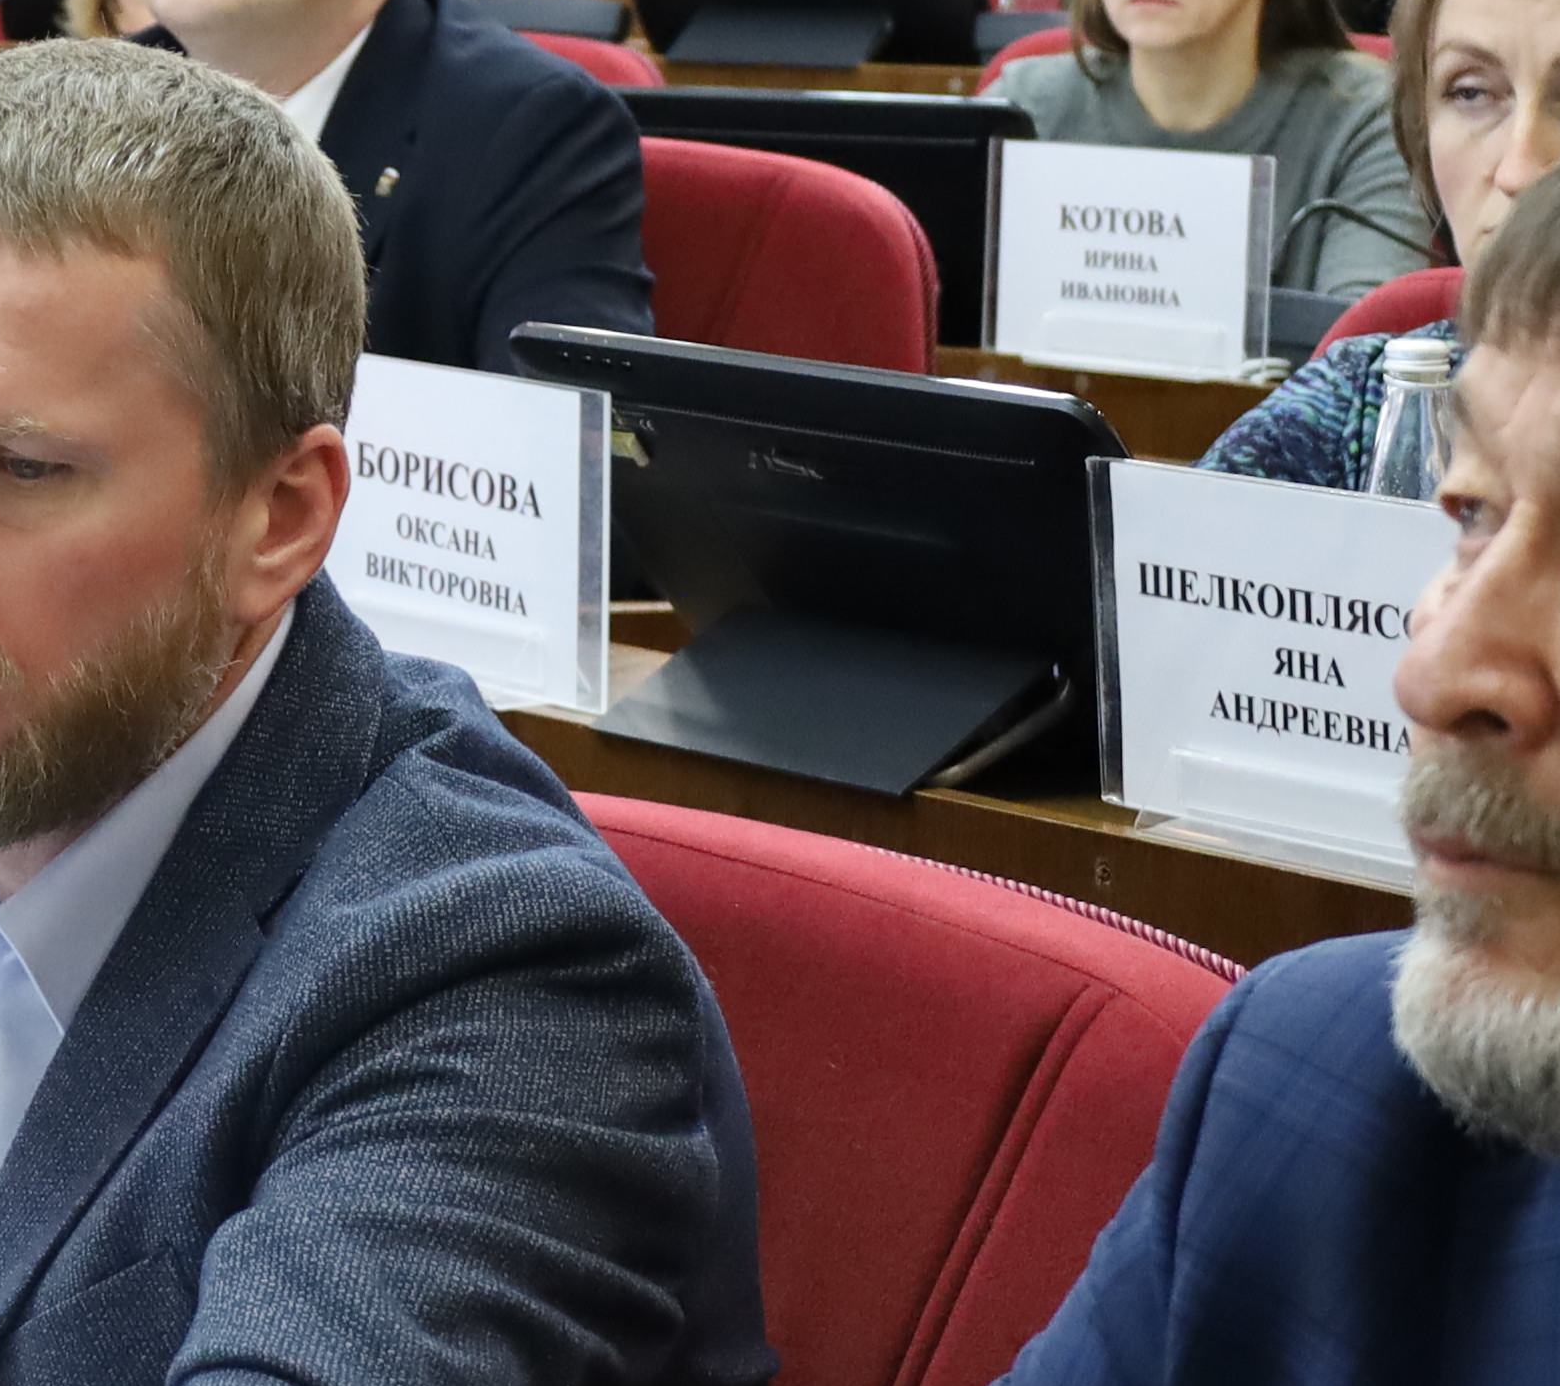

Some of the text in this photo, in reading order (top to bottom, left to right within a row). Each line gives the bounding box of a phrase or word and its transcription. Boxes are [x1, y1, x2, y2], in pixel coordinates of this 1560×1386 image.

[1060, 205, 1185, 238] КОТОВА
[1083, 249, 1158, 273] ИРИНА
[1061, 281, 1180, 307] ИВАНОВНА
[356, 440, 543, 520] БОРИСОВА
[396, 512, 497, 562] ОКСАНА
[365, 551, 528, 617] ВИКТОРОВНА
[1273, 647, 1346, 689] ЯНА
